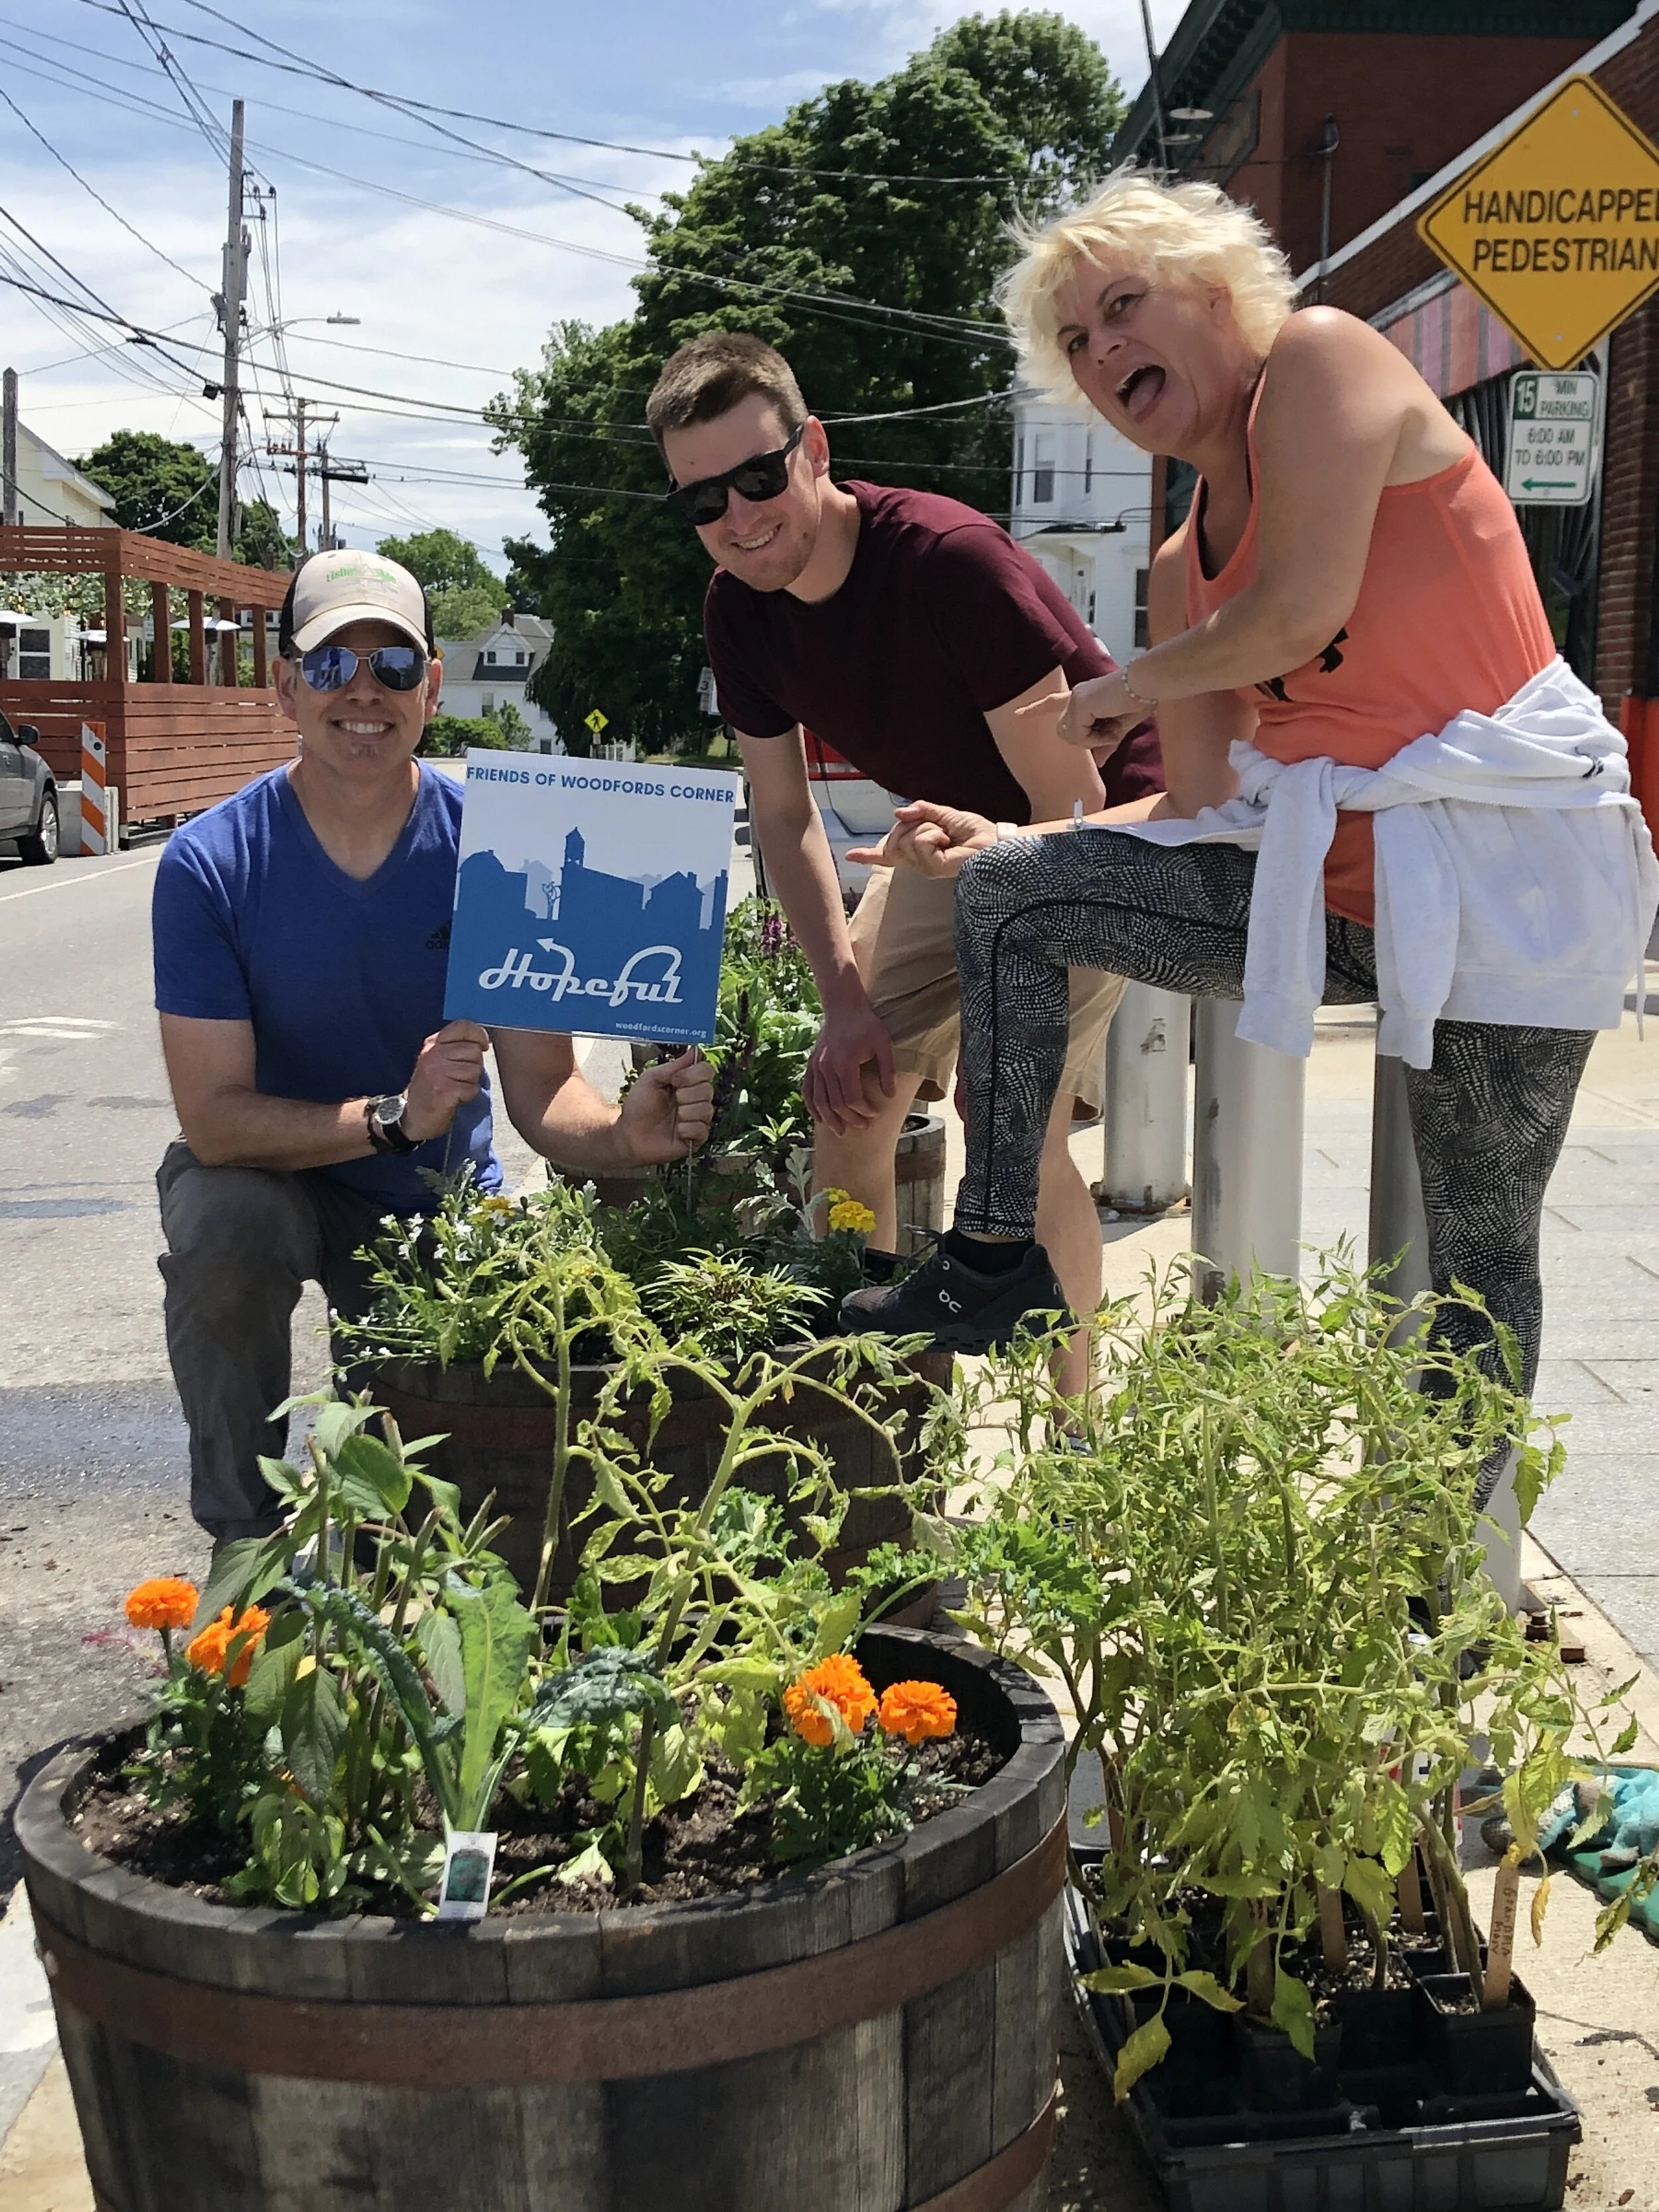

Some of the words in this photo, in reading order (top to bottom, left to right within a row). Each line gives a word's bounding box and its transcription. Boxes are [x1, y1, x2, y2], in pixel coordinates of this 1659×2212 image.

[1463, 188, 1659, 224] HANDICAPPE
[1473, 238, 1659, 273] PEDESTRIAN
[1516, 380, 1536, 413] 15
[1555, 379, 1577, 394] MIN
[1541, 401, 1589, 416] PARKING
[1558, 429, 1575, 443] AM
[1516, 449, 1531, 465] TO
[1568, 450, 1585, 465] PM
[467, 766, 530, 784] FRIENDS
[535, 773, 556, 786] OF
[561, 775, 664, 796] WOODFORDS
[670, 785, 734, 803] CORNER
[478, 938, 684, 1007] Hopeful
[615, 1022, 707, 1039] woodfordscorner.org
